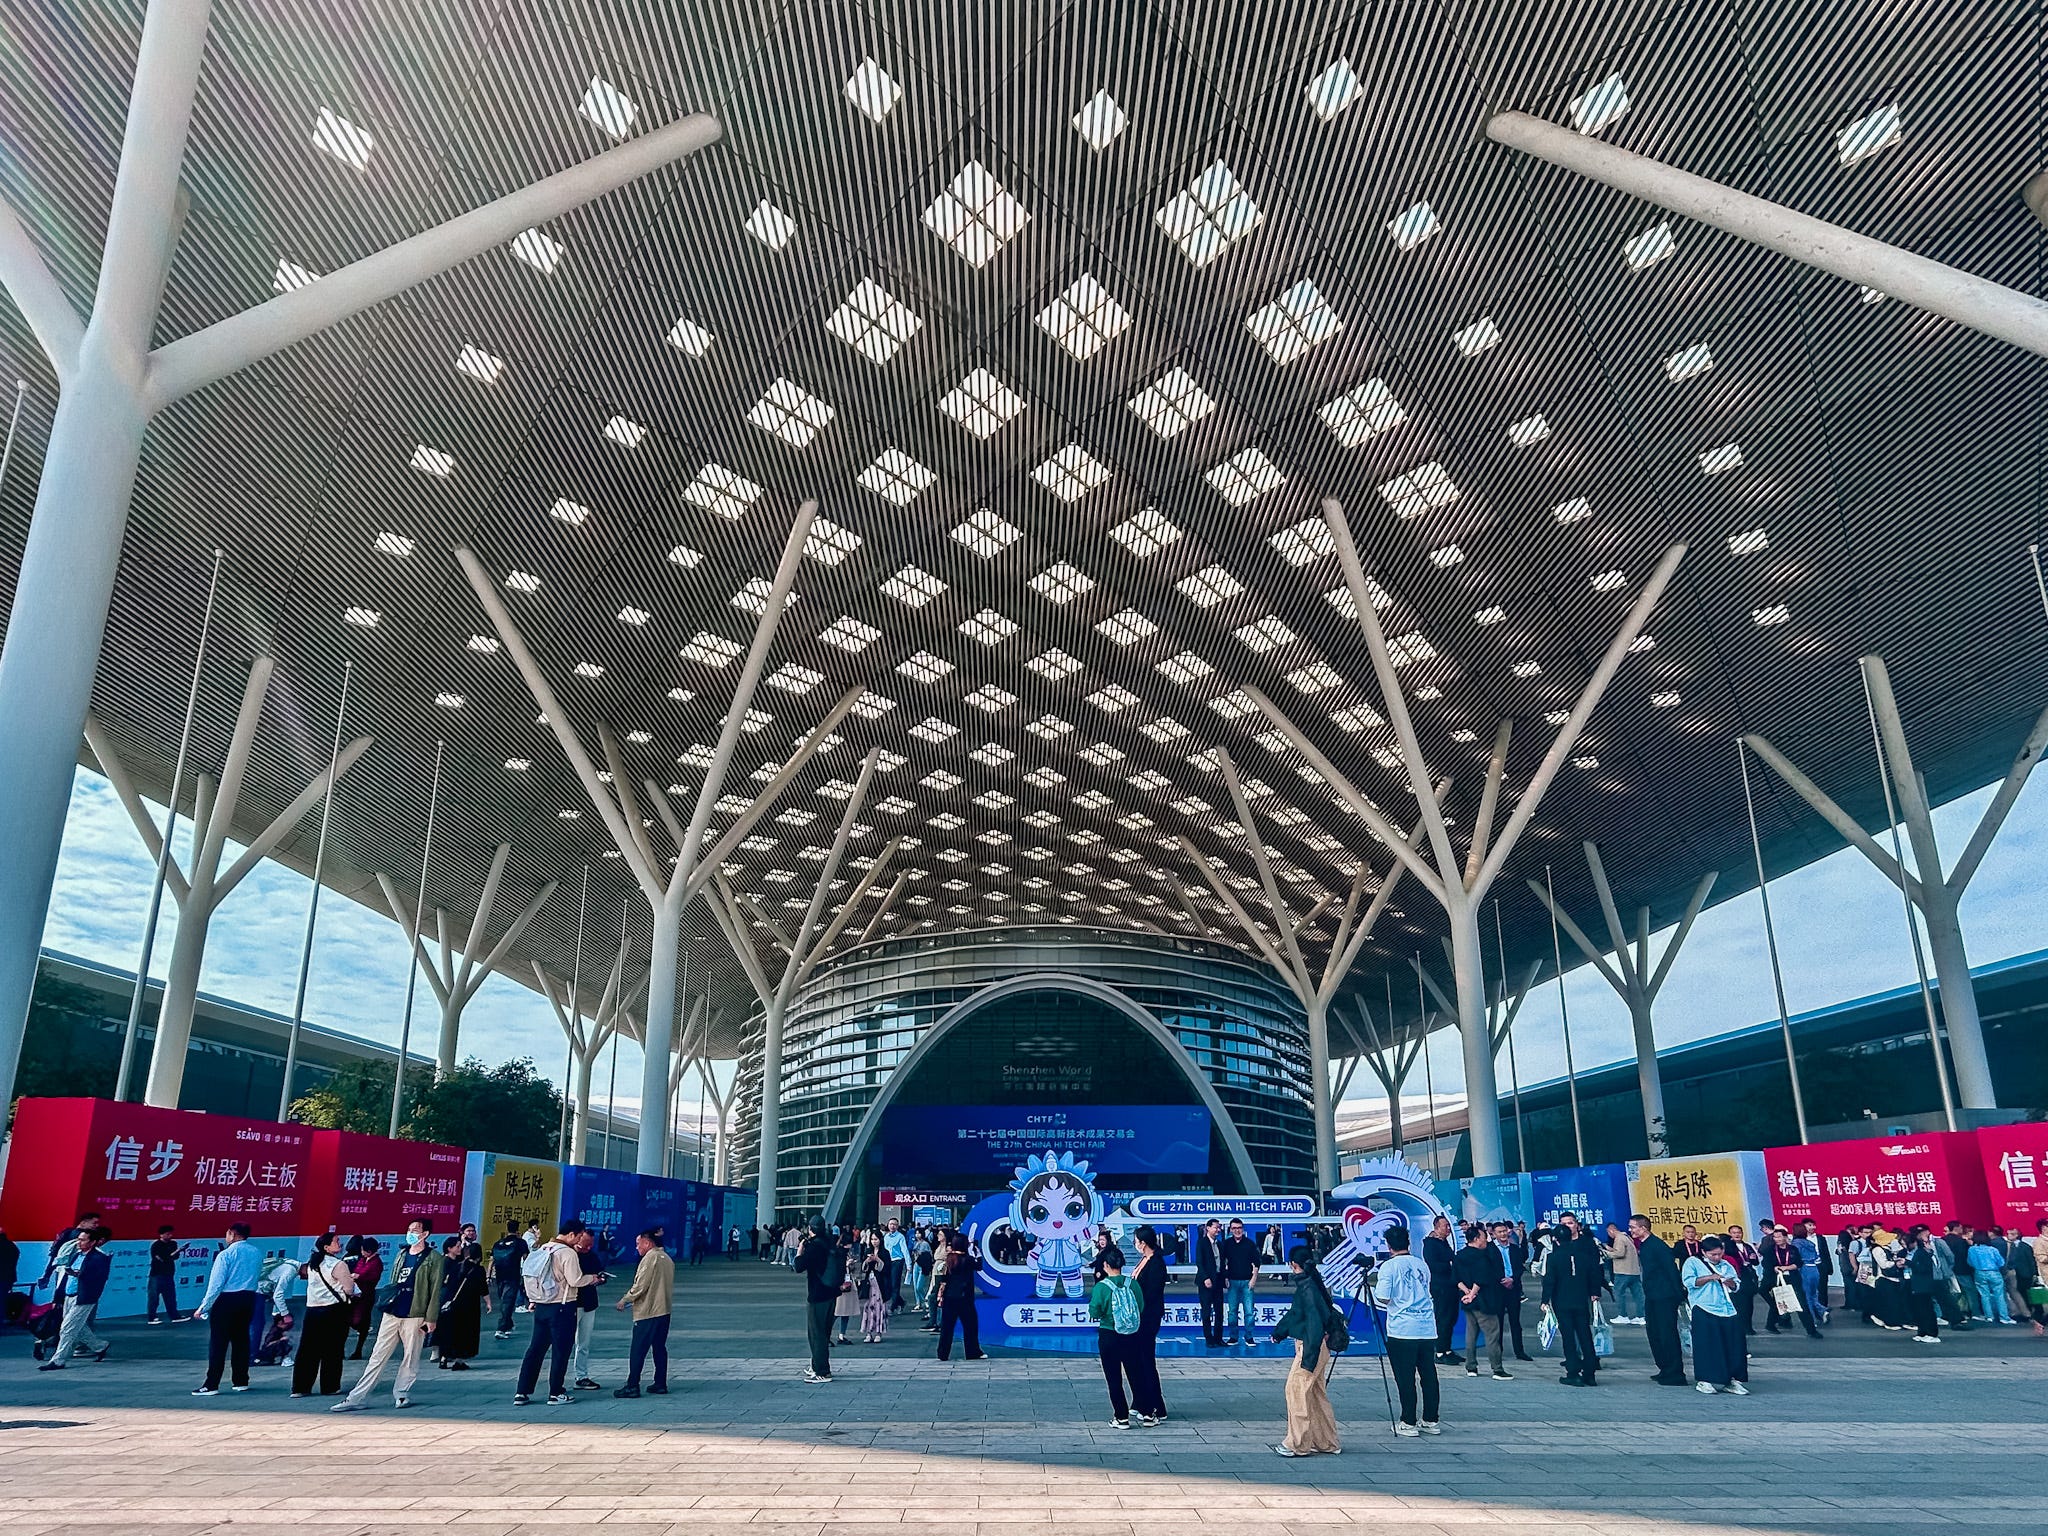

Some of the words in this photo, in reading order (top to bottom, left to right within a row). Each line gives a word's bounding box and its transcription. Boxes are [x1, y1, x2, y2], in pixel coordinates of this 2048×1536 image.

[1002, 1065, 1055, 1074] Shenzhen
[1027, 1116, 1053, 1124] CHTF
[236, 1128, 260, 1141] SEAVO
[957, 1129, 1135, 1139] 第二十七届中国国际高新技术成果交易会
[987, 1141, 1001, 1149] THE
[1004, 1141, 1023, 1149] 27th
[1025, 1141, 1051, 1149] CHINA
[1088, 1141, 1106, 1149] FAIR
[105, 1135, 184, 1181] 信步
[194, 1156, 298, 1188] 机器人主板
[1998, 1150, 2048, 1189] 信
[344, 1167, 399, 1193] 联祥1号
[404, 1177, 457, 1196] 工业计算机
[504, 1170, 543, 1200] 陈与陈
[1654, 1169, 1712, 1200] 陈与陈
[1777, 1169, 1820, 1197] 稳信
[1825, 1171, 1937, 1195] 机器人控制器
[189, 1195, 243, 1212] 具身智能
[245, 1196, 294, 1212] 主板专家
[895, 1194, 927, 1203] 观众入口
[1147, 1202, 1165, 1212] THE
[1170, 1202, 1193, 1212] 27th
[1197, 1202, 1232, 1212] CHINA
[1235, 1202, 1277, 1212] HI-TECH
[1281, 1201, 1304, 1211] FAIR
[1553, 1193, 1588, 1208] 中国信保
[493, 1205, 549, 1224] 品牌定位设计
[1543, 1209, 1603, 1225] 中国护航者
[1648, 1205, 1728, 1225] 品牌定位设计
[1830, 1202, 1942, 1216] 超200家具身智能都在用
